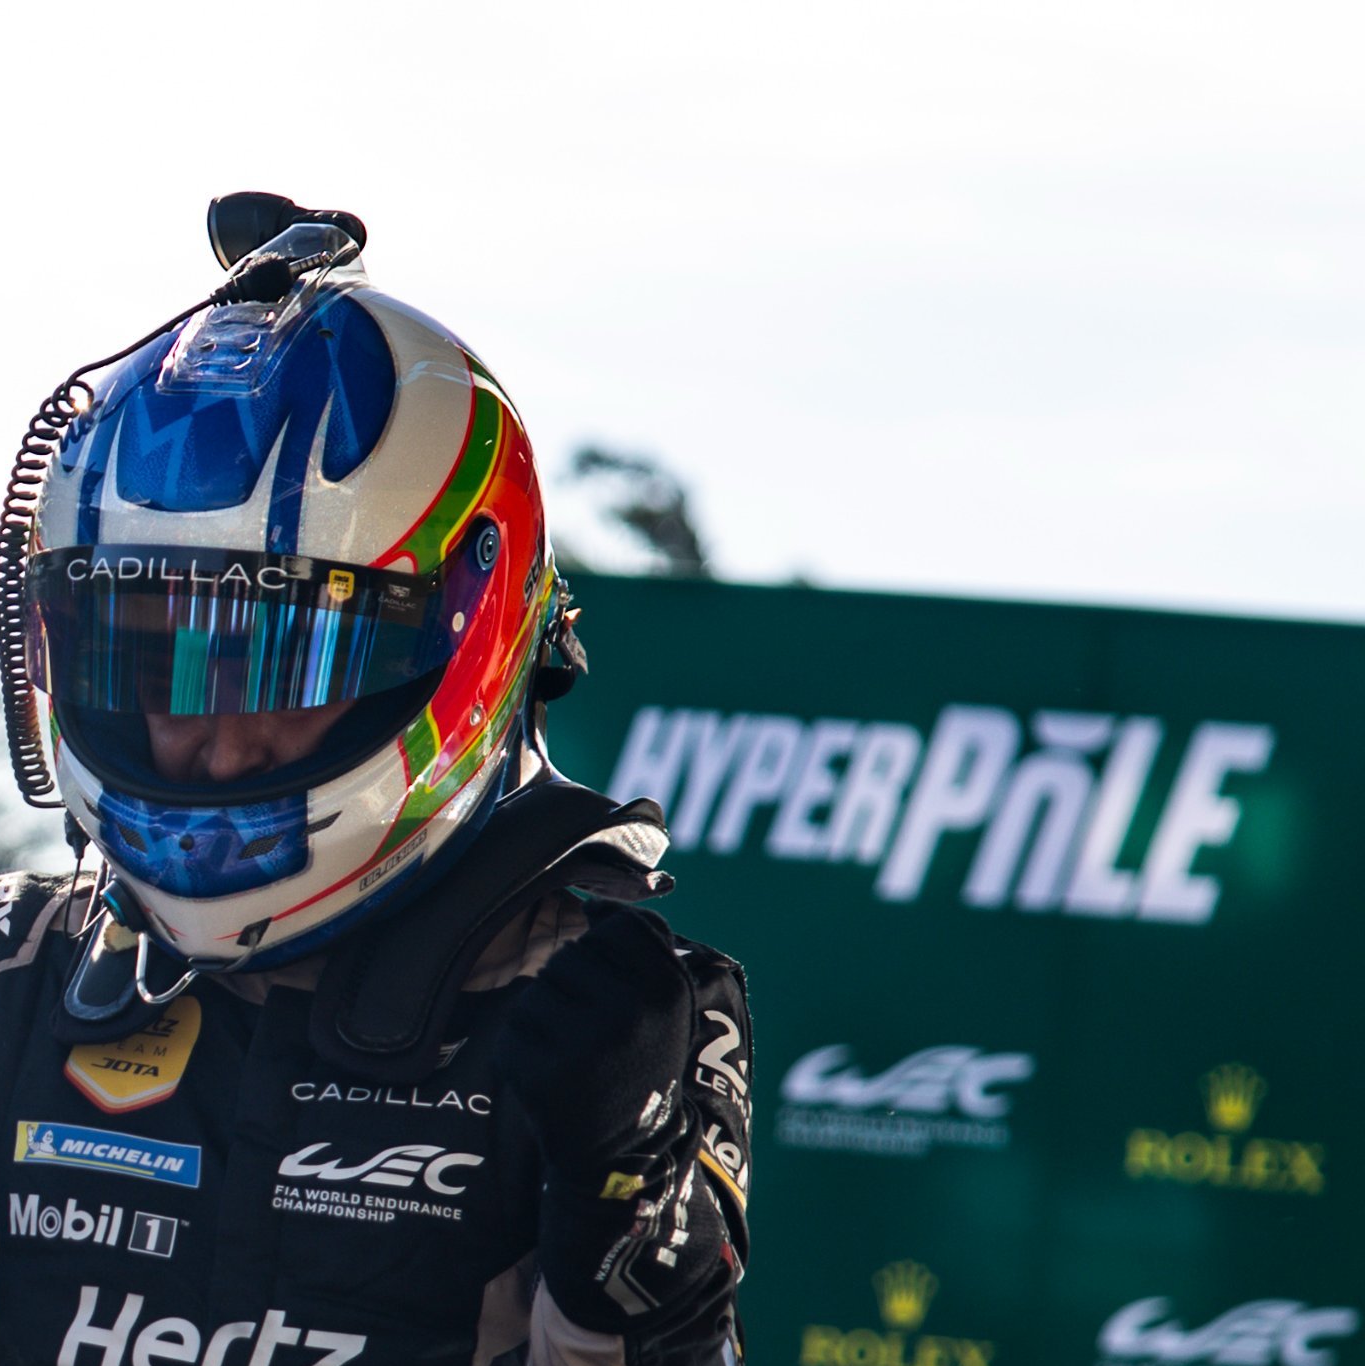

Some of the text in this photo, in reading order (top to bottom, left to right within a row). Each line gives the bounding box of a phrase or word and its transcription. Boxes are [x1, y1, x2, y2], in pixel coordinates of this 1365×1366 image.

[67, 555, 288, 590] CADILLAC
[91, 1057, 160, 1077] JOTA
[101, 1042, 168, 1058] EAM
[291, 1082, 492, 1115] CADILLAC
[780, 1044, 1035, 1118] WEC
[59, 1138, 185, 1173] MICHELIN
[278, 1142, 486, 1196] WEC
[1125, 1126, 1325, 1195] ROLEX
[9, 1192, 123, 1247] Mobil
[271, 1196, 395, 1223] CHAMPIONSHIP
[274, 1184, 463, 1221] FIA WORLD ENDURANCE
